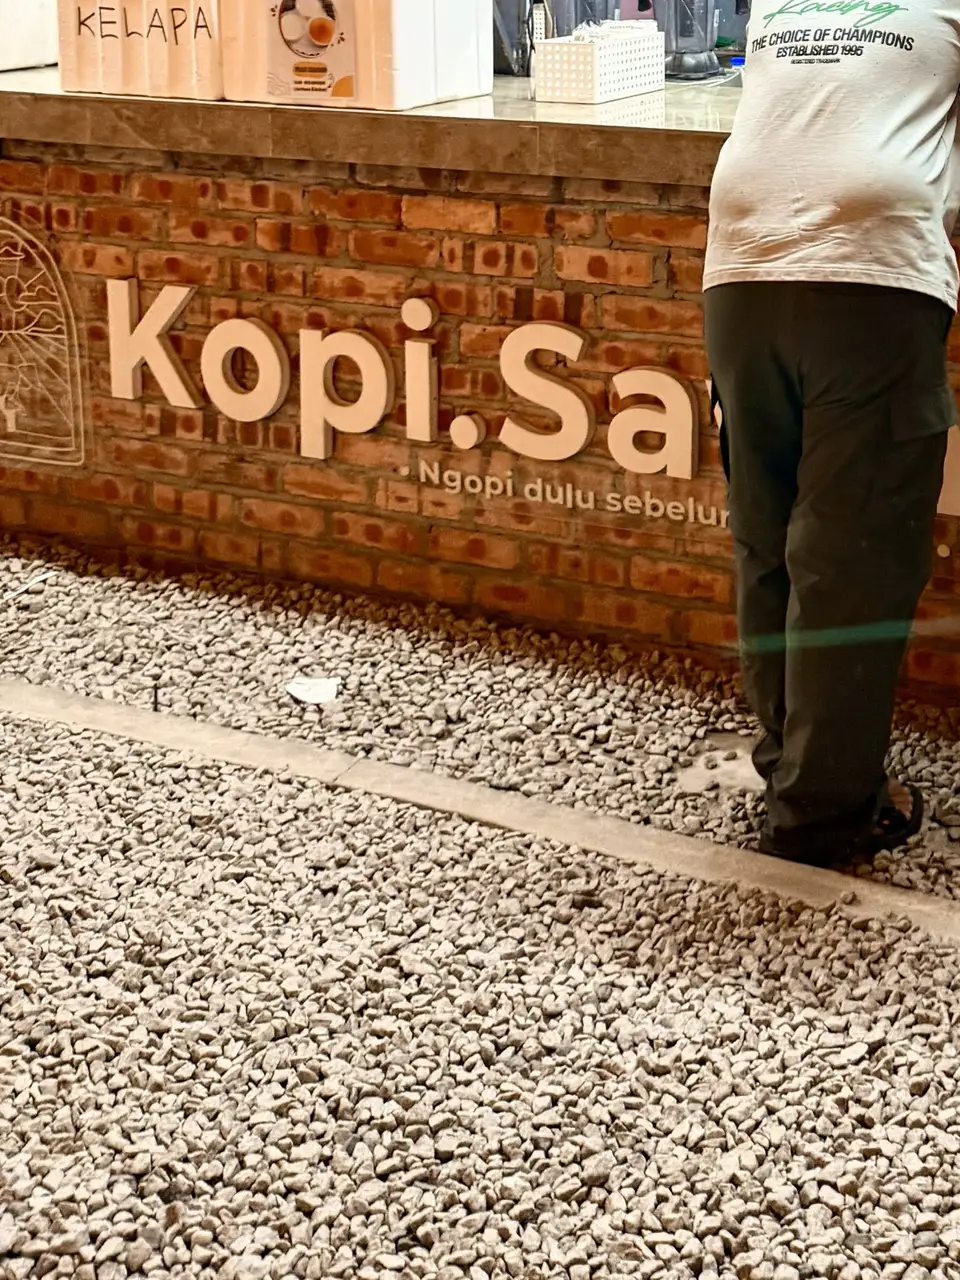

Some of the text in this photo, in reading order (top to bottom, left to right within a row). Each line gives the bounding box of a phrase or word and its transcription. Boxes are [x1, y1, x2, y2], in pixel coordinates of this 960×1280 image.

[77, 6, 212, 45] KELAPA
[752, 28, 914, 53] THE CHOICE OF CHAMPIONS
[776, 45, 864, 58] ESTABLISHED 1995
[419, 460, 513, 500] Ngopi
[524, 476, 595, 511] dulu
